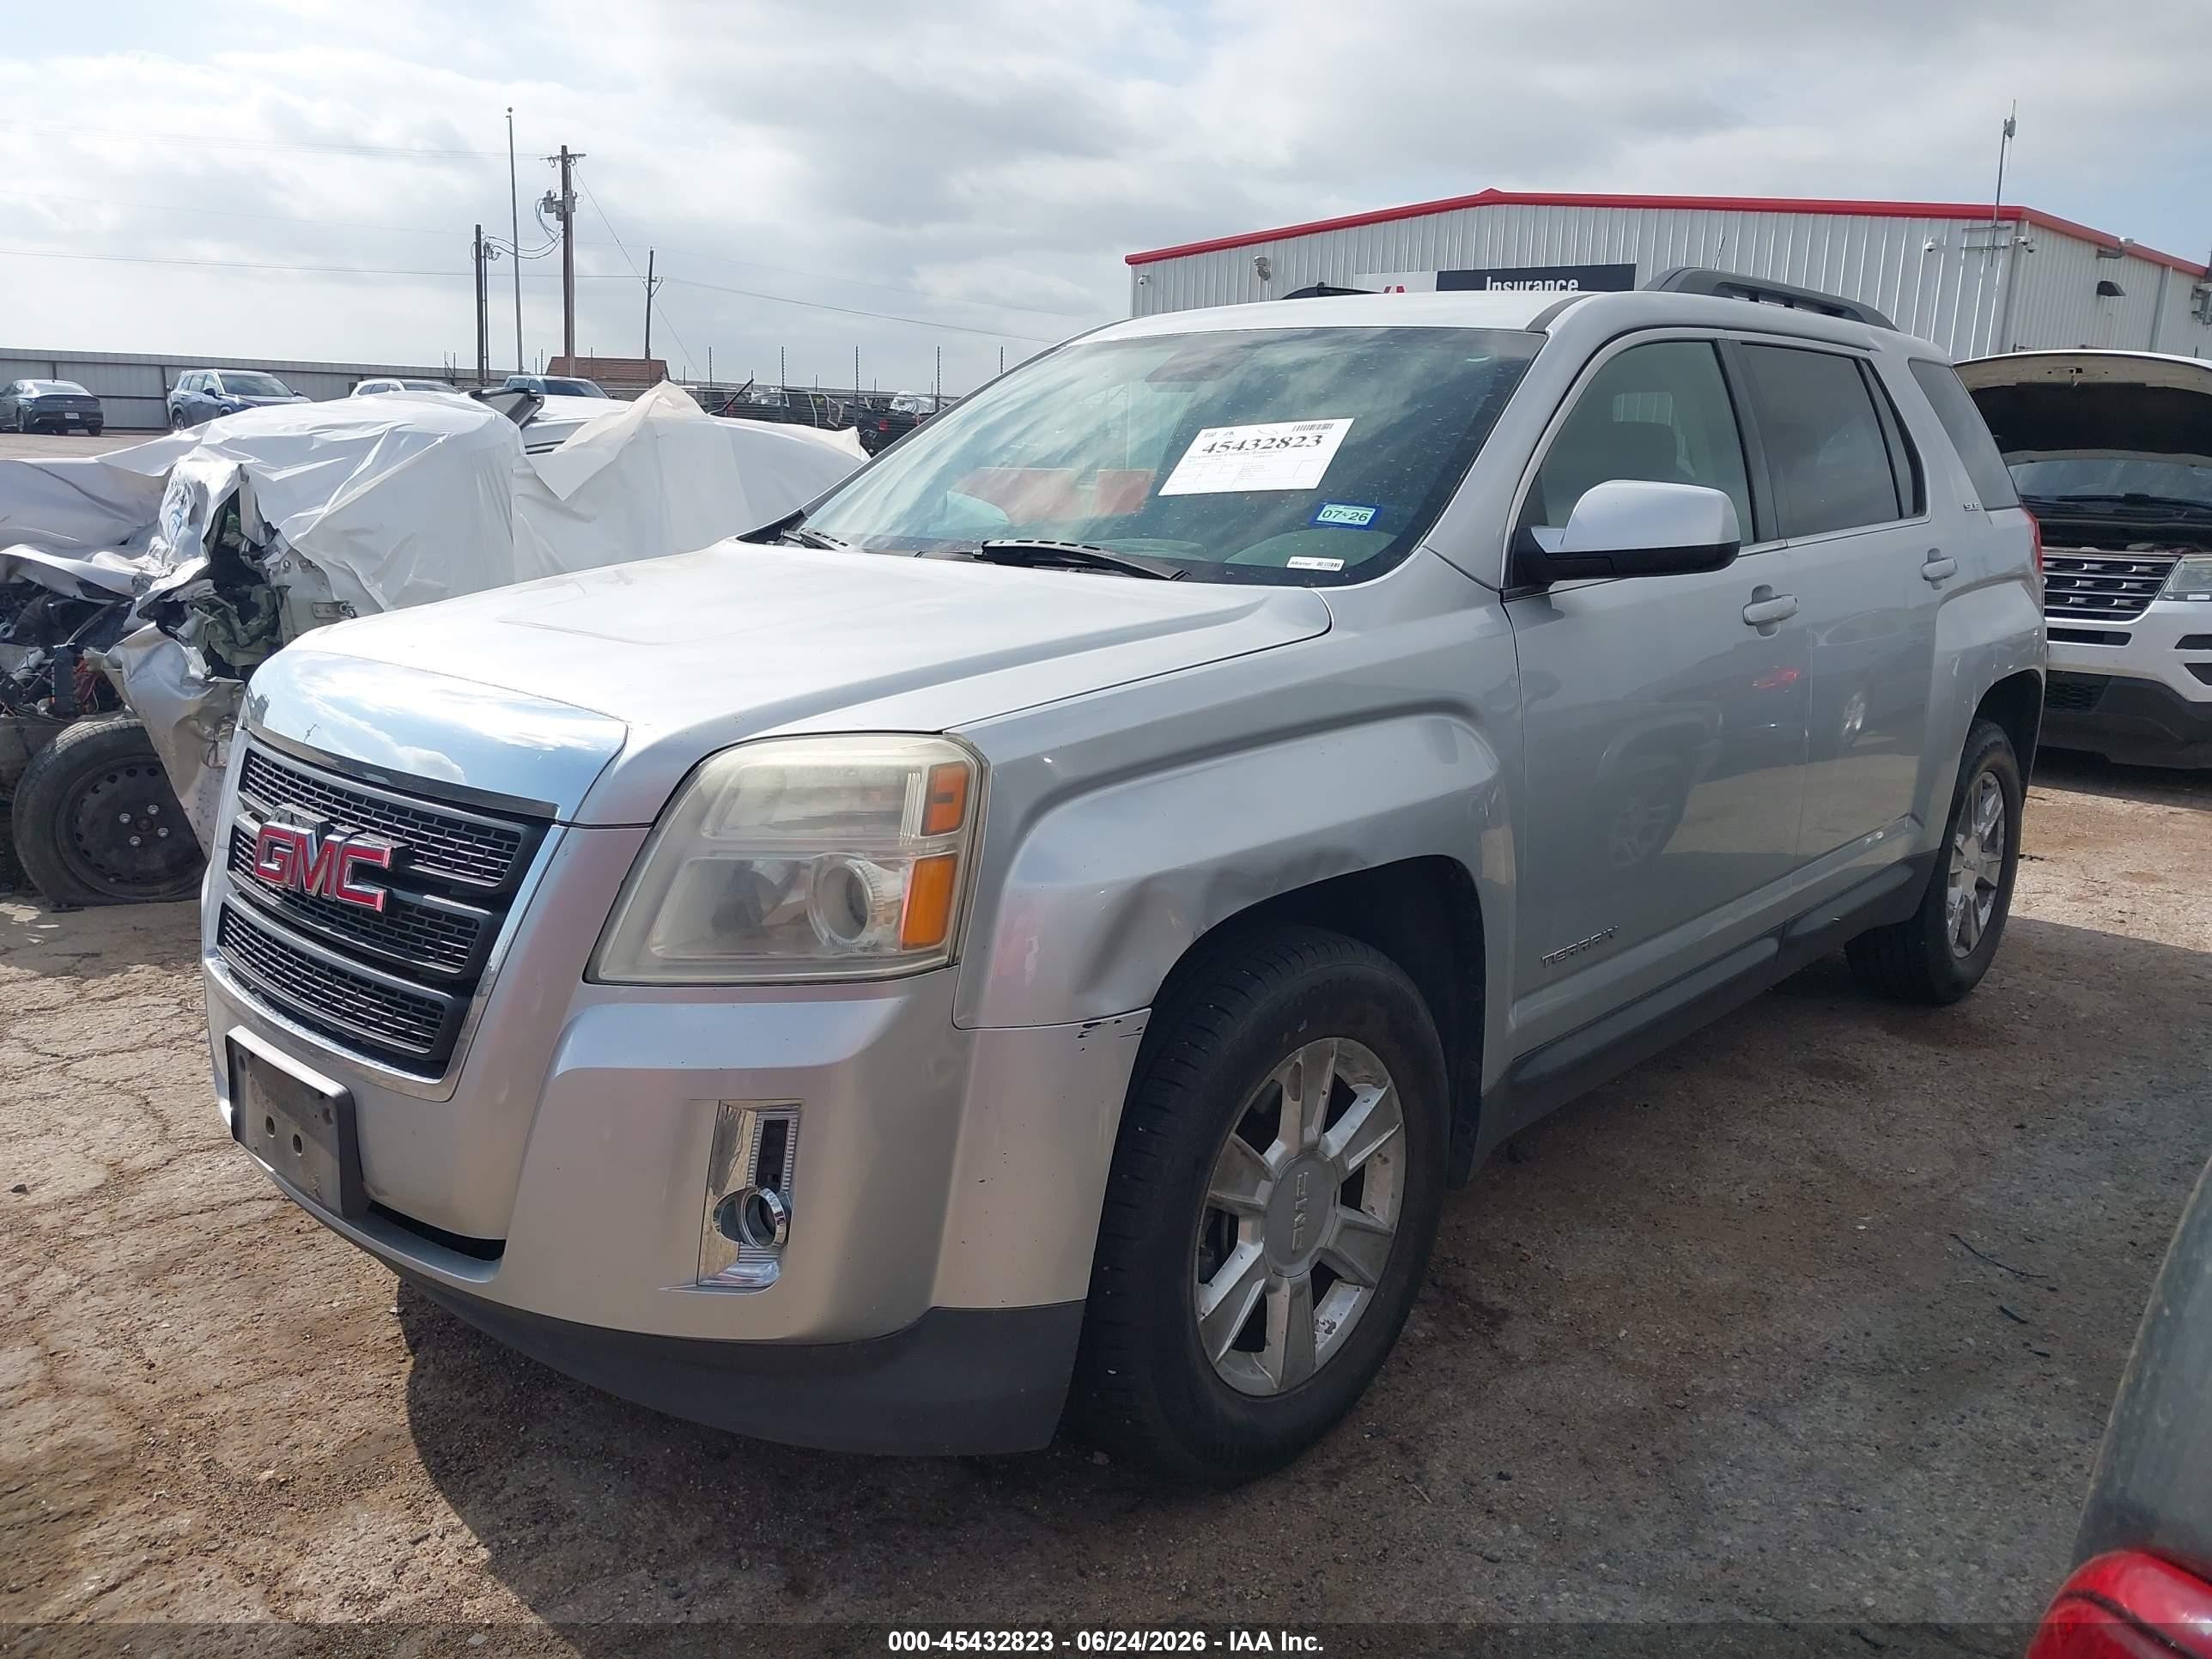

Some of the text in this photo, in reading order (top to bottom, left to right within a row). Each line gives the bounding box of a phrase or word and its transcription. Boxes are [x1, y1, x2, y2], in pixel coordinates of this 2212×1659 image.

[1486, 276, 1579, 291] Insurance
[1202, 434, 1322, 453] 45432823
[255, 820, 392, 913] GMC
